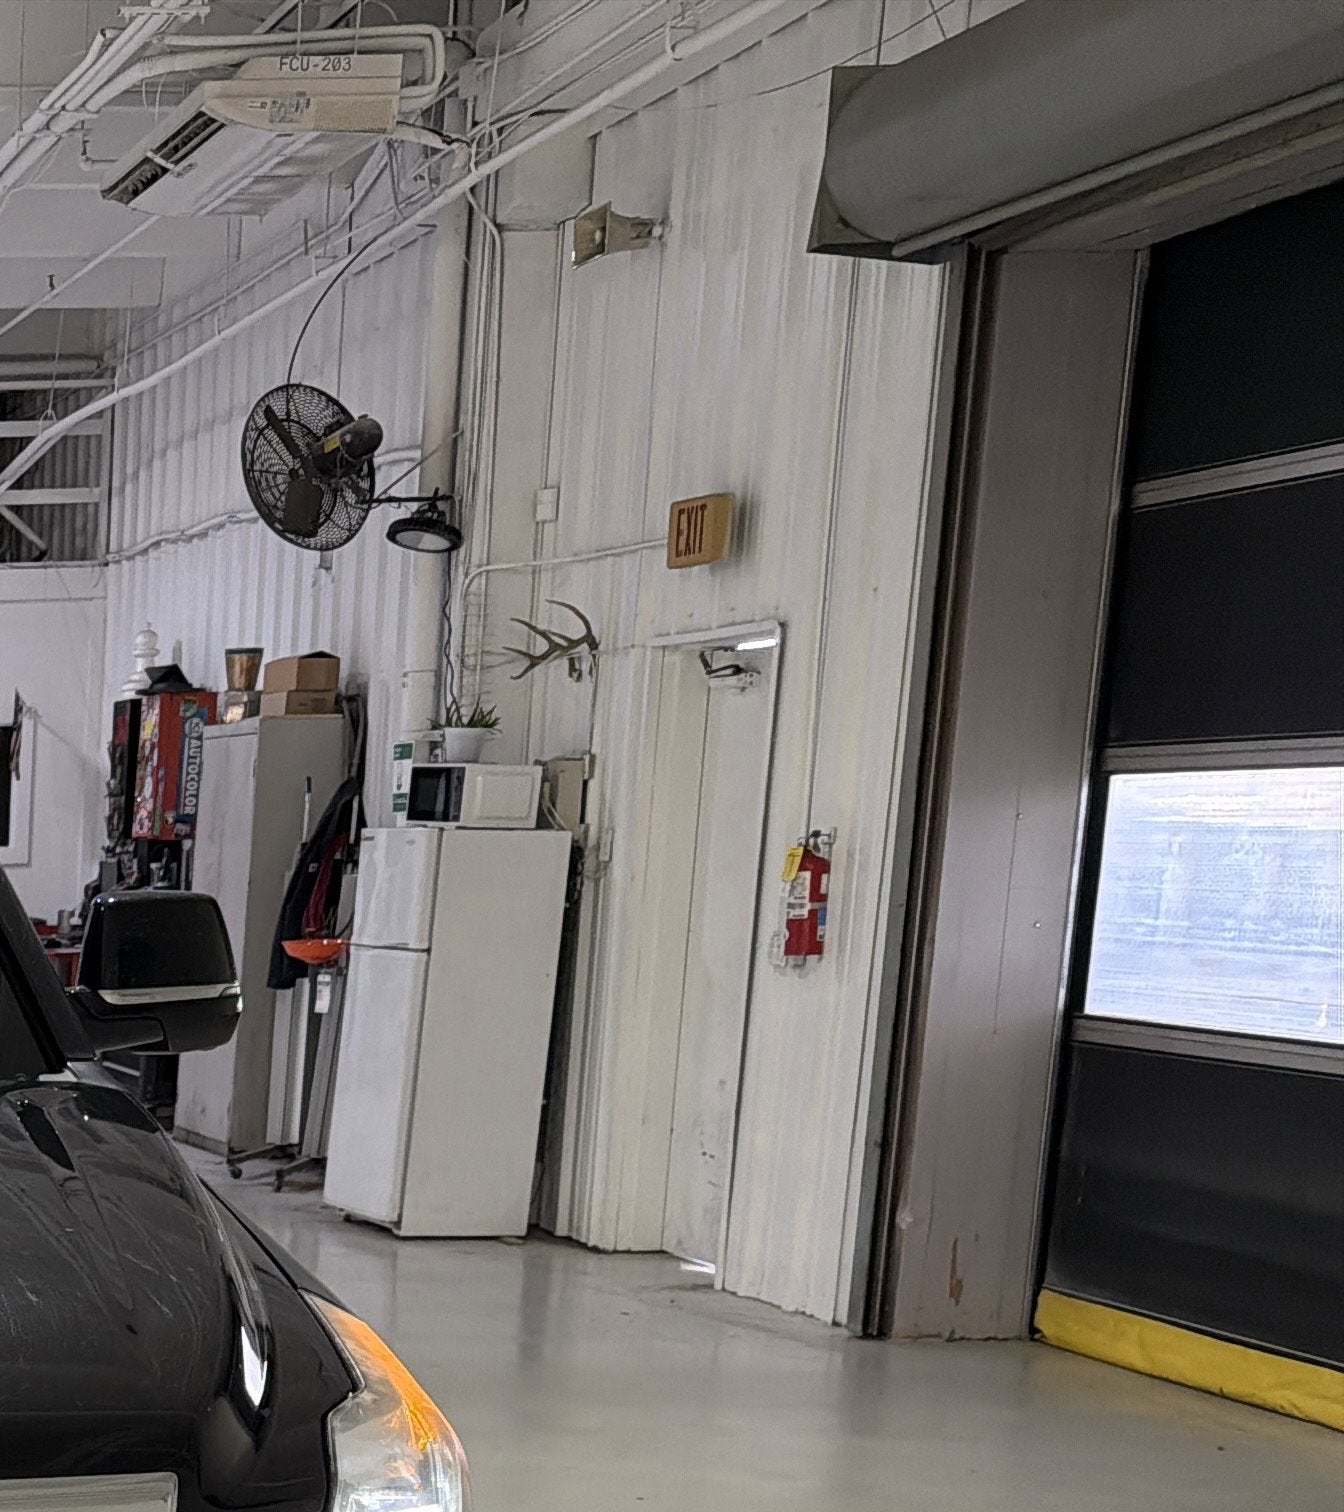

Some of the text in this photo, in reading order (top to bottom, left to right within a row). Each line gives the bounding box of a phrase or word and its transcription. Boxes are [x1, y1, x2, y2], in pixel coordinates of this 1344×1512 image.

[278, 56, 352, 72] FCU-203
[675, 503, 707, 558] EXIT
[183, 739, 201, 815] AUTOCOLOR
